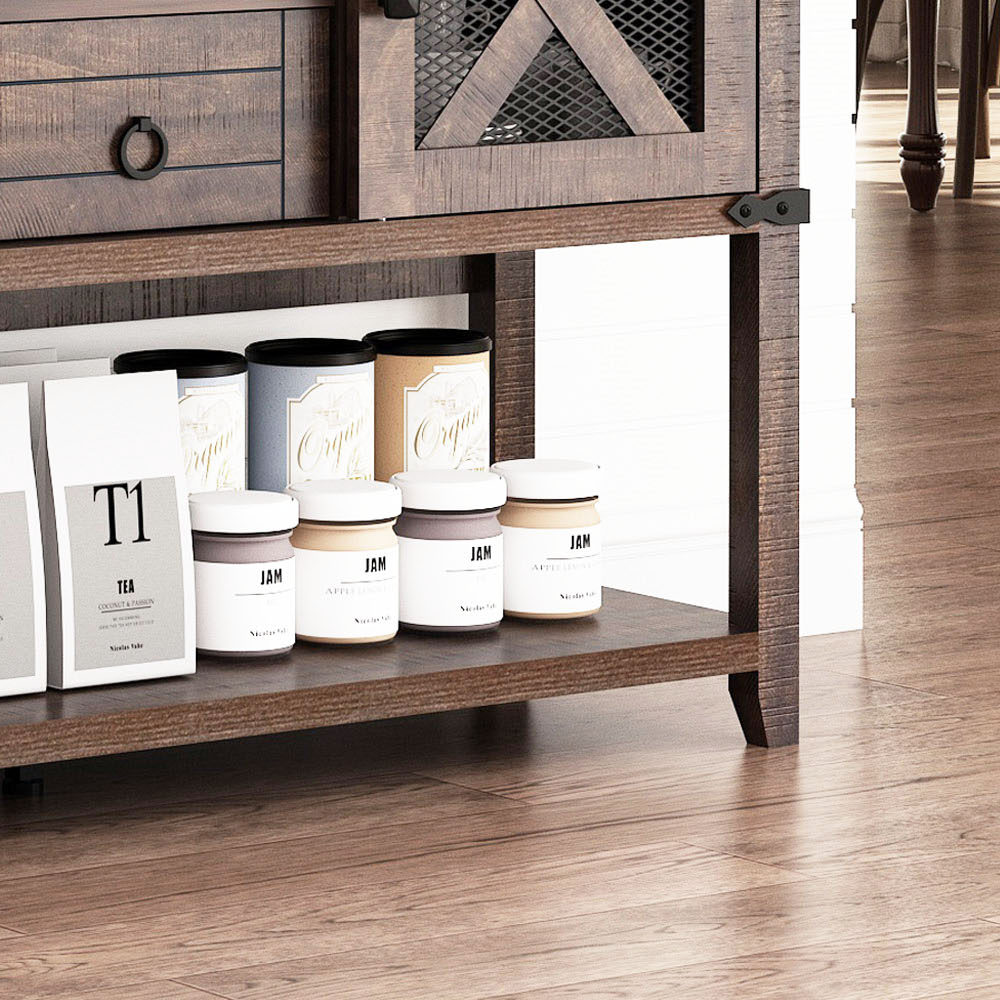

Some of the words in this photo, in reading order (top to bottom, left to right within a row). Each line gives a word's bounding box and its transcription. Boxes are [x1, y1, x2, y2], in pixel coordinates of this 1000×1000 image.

[93, 480, 151, 546] T1
[570, 533, 591, 550] JAM
[471, 545, 492, 562] JAM
[365, 556, 386, 573] JAM
[260, 568, 283, 585] JAM
[117, 579, 135, 595] TEA
